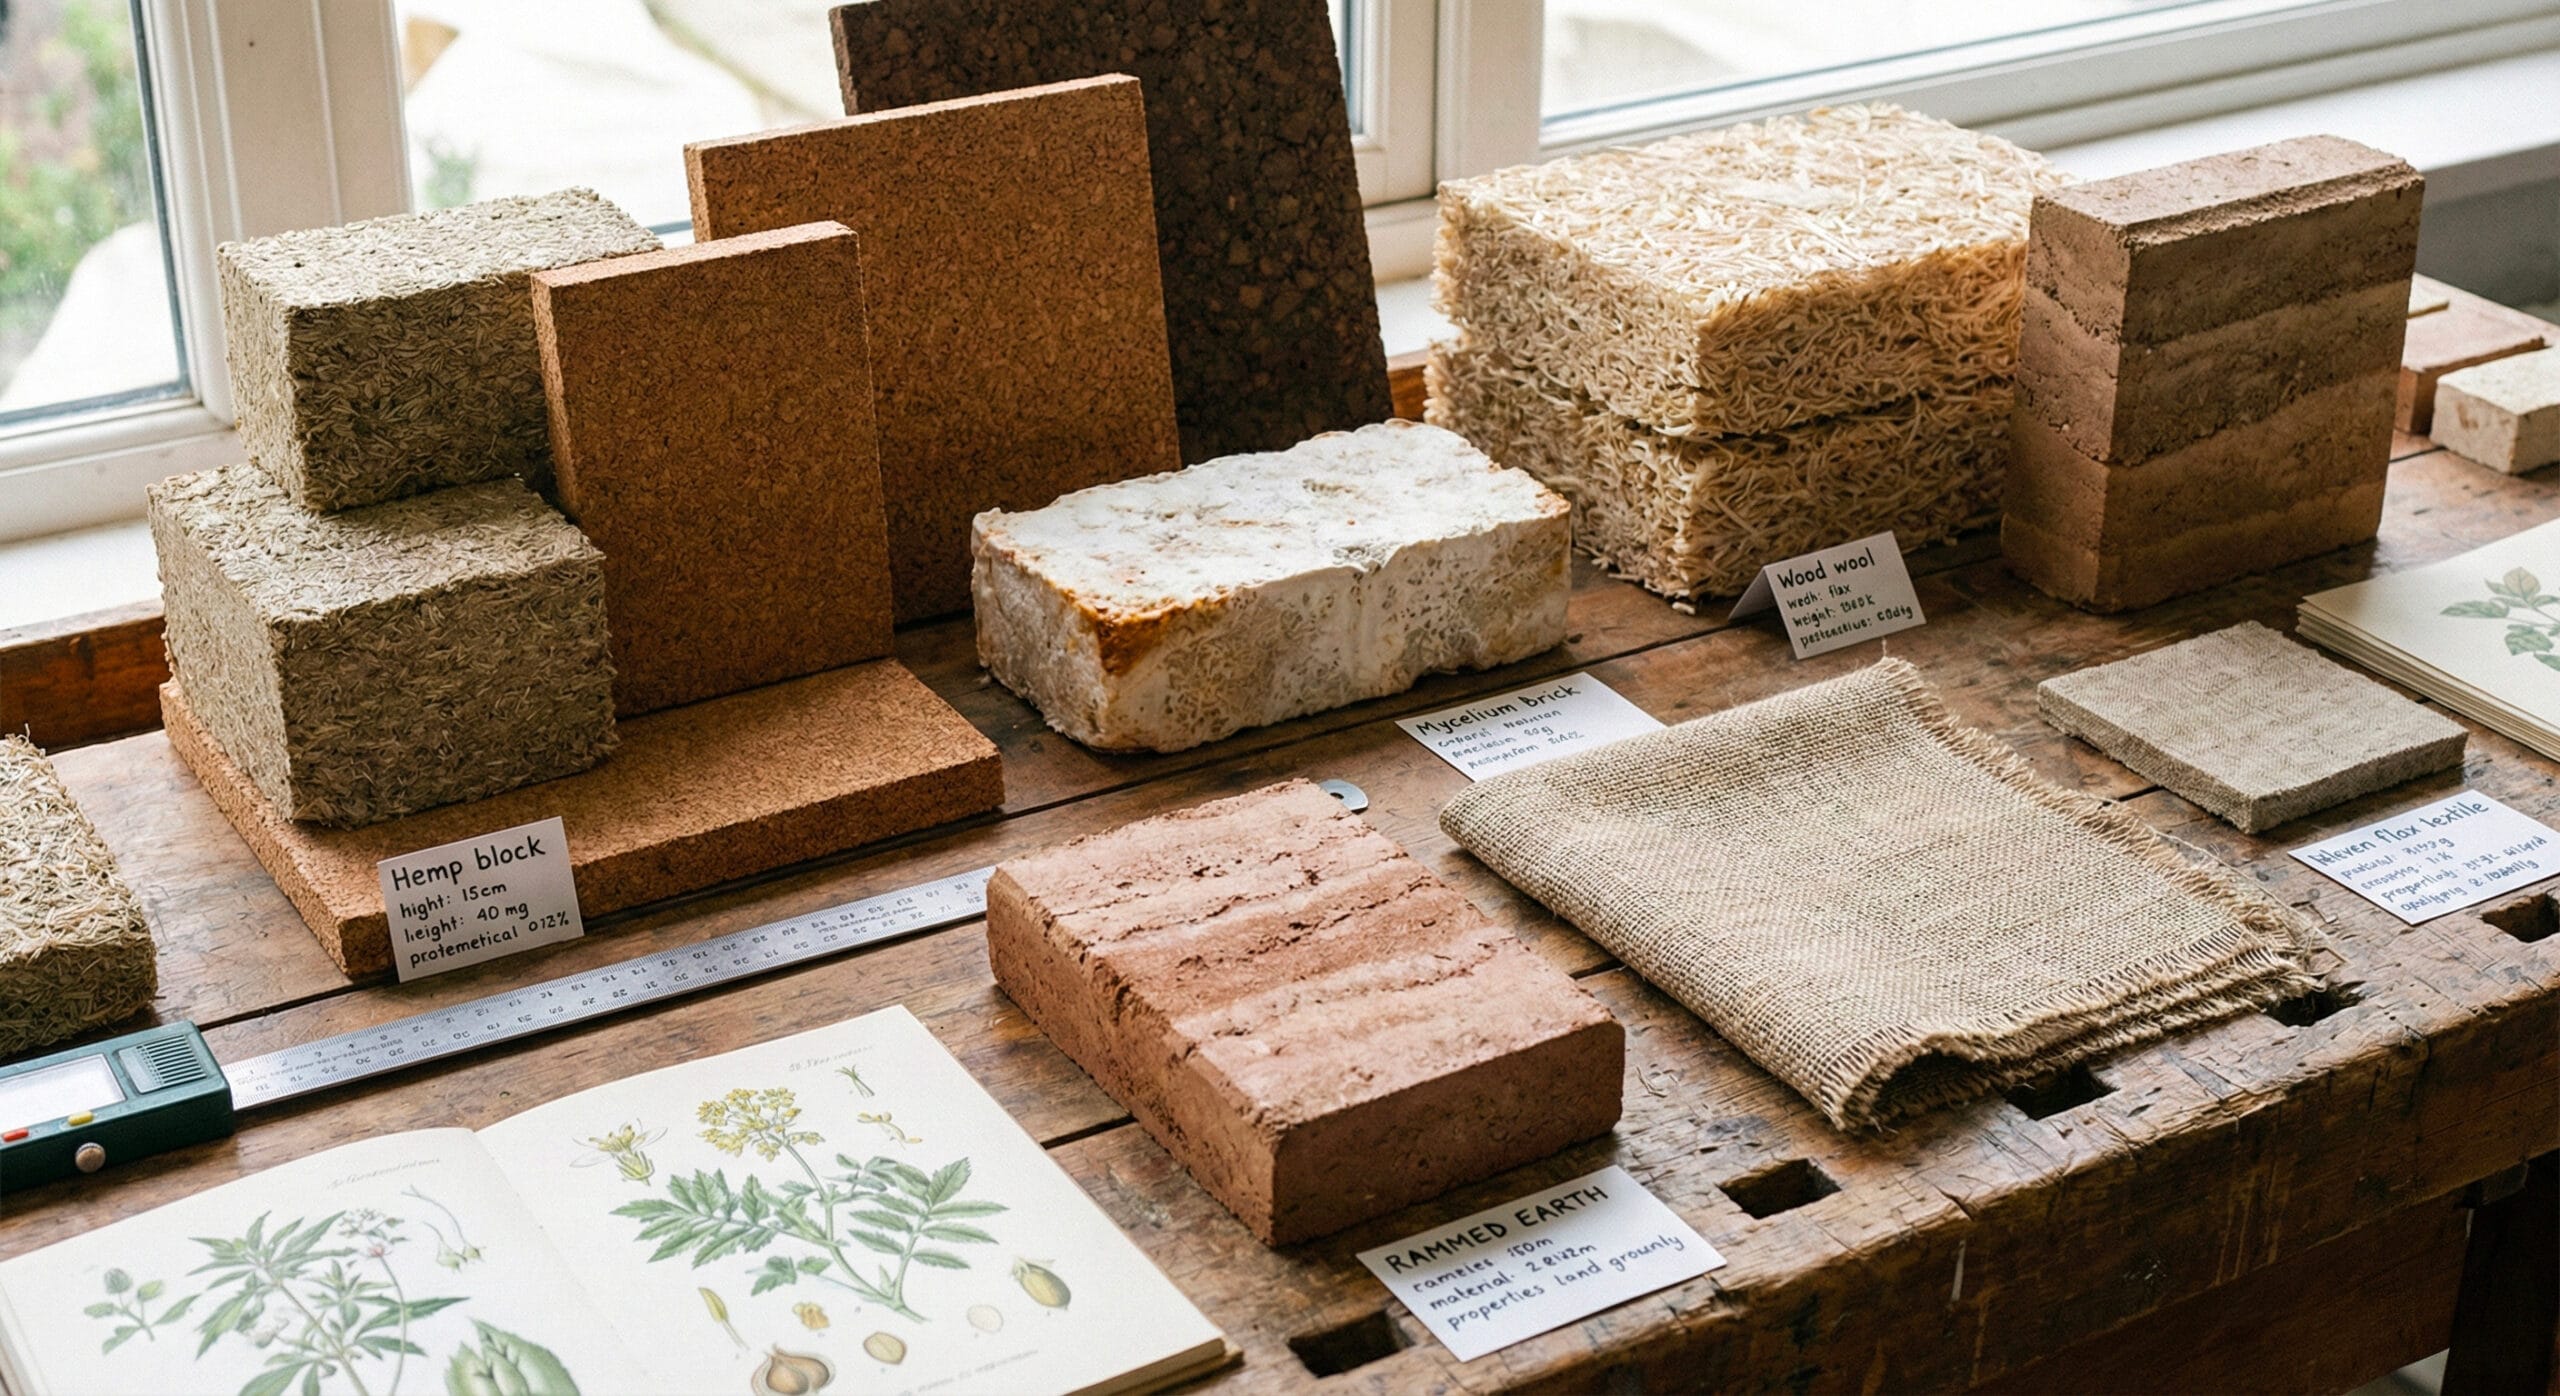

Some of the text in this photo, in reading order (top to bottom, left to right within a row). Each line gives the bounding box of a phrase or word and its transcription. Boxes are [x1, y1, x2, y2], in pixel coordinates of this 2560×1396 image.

[1777, 547, 1875, 589] Wood wool
[1829, 584, 1852, 599] flax
[1416, 685, 1581, 736] Mycelium Brick
[2374, 825, 2422, 844] flax
[2419, 801, 2490, 828] textile
[391, 835, 546, 891] Hemp block
[400, 884, 507, 921] hight: 15cm
[476, 906, 499, 922] 40
[505, 902, 529, 920] mg
[1385, 1185, 1609, 1275] RAMMED EARTH
[1447, 1284, 1546, 1332] properties
[1554, 1258, 1603, 1287] land
